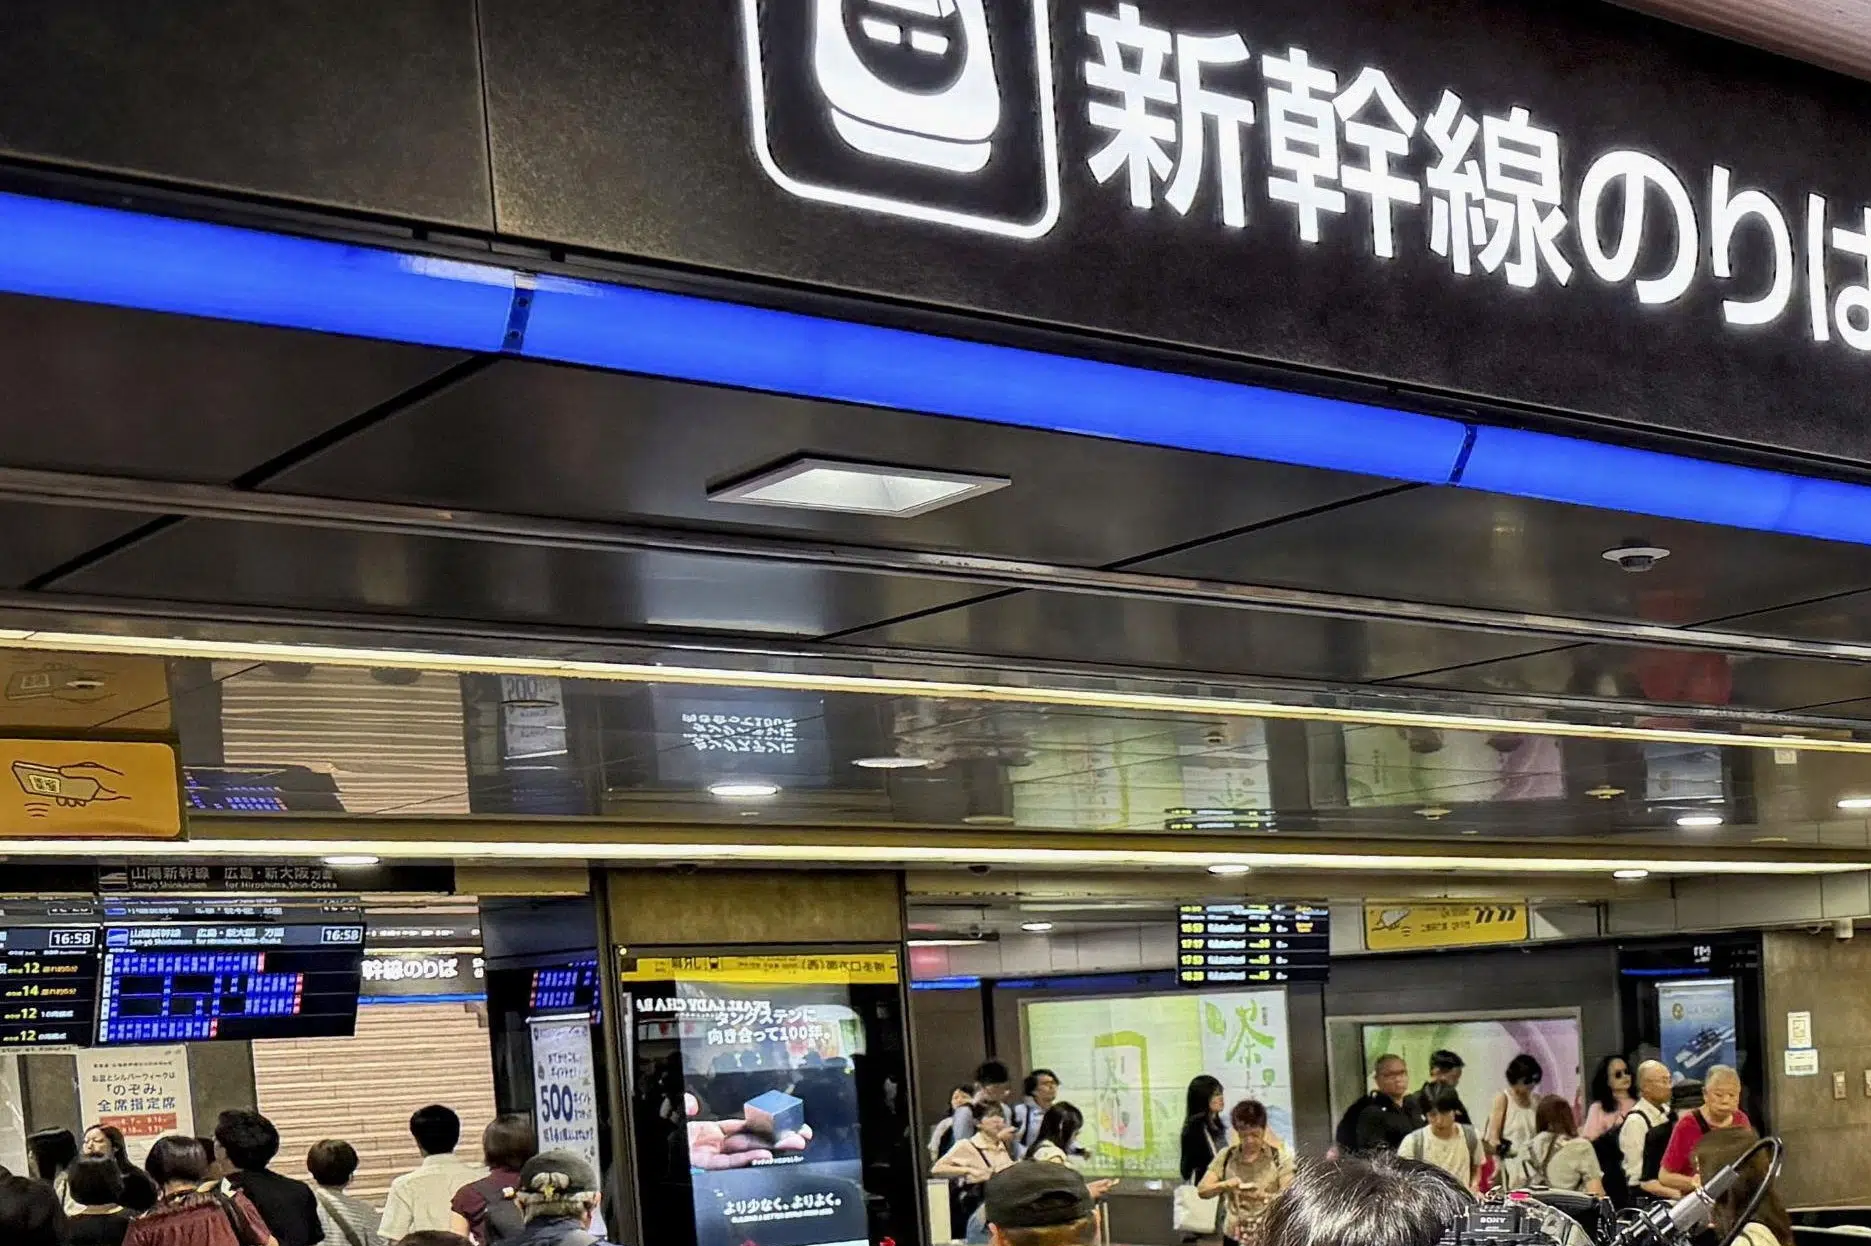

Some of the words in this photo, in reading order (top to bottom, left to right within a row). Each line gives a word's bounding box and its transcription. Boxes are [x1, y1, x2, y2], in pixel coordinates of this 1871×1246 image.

[53, 933, 92, 945] 16:58
[325, 929, 359, 941] 16:58
[23, 962, 40, 974] 12
[22, 985, 39, 996] 14
[21, 1008, 37, 1019] 12
[716, 1008, 817, 1028] タングステンに
[20, 1030, 36, 1041] 12
[106, 1083, 163, 1096] 「のぞみ」
[97, 1097, 176, 1112] 全席指定席
[540, 1083, 573, 1122] 500
[1480, 1216, 1507, 1224] SONY
